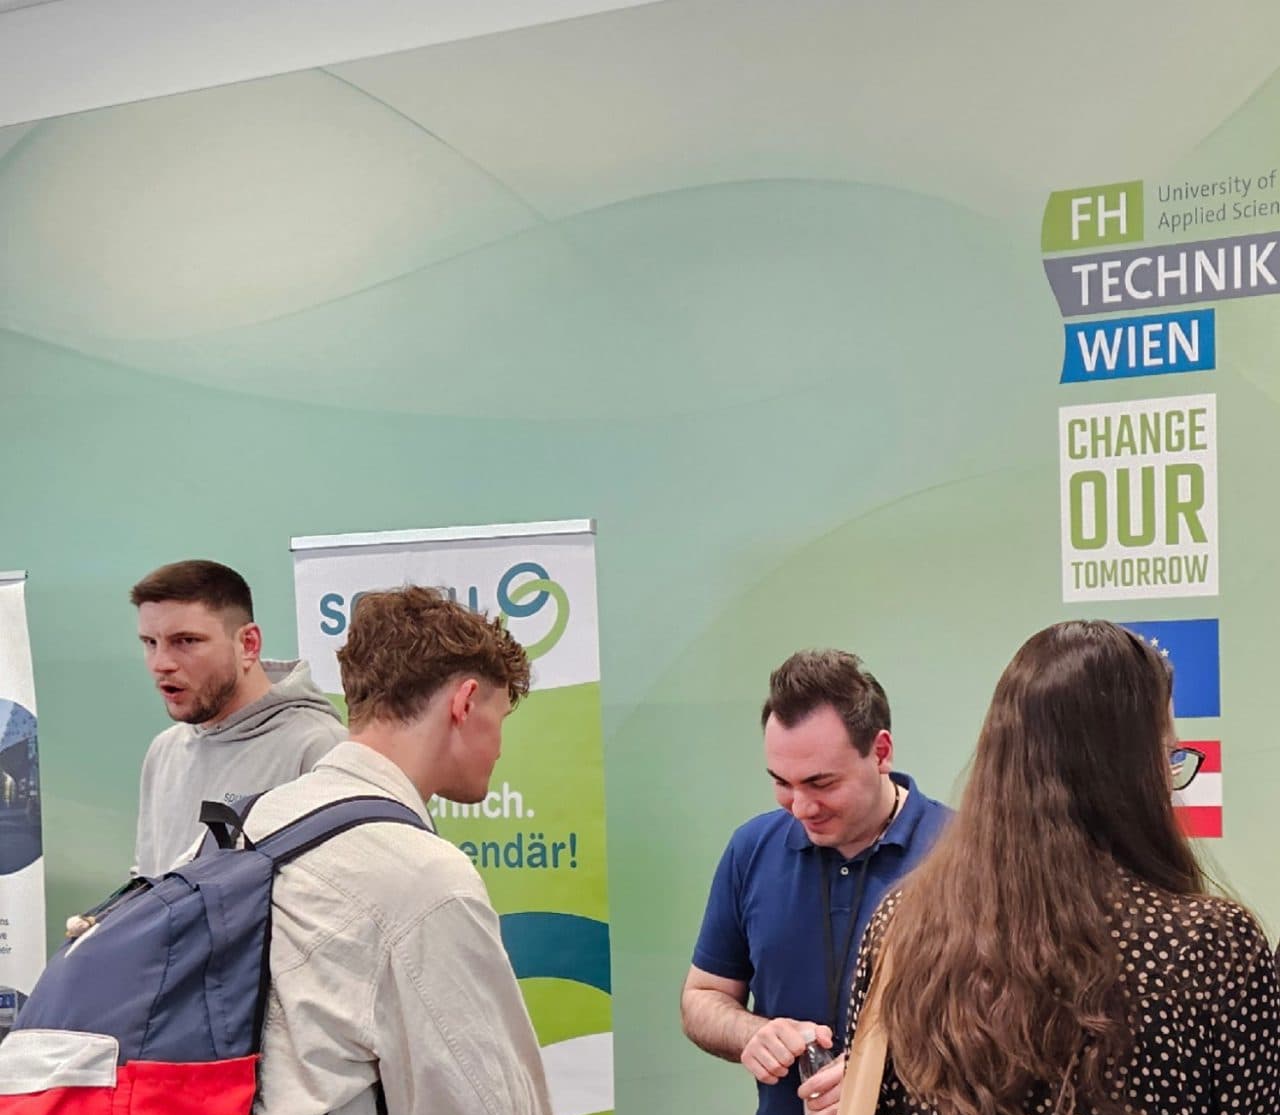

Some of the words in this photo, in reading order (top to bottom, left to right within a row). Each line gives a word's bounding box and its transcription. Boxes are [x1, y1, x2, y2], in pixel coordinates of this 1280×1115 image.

[1157, 175, 1252, 203] University
[1257, 168, 1278, 190] of
[1071, 191, 1127, 241] FH
[1157, 204, 1227, 233] Applied
[1077, 319, 1199, 372] WIEN
[1067, 407, 1208, 460] CHANGE
[1069, 463, 1208, 550] OUR
[1071, 554, 1208, 589] TOMORROW
